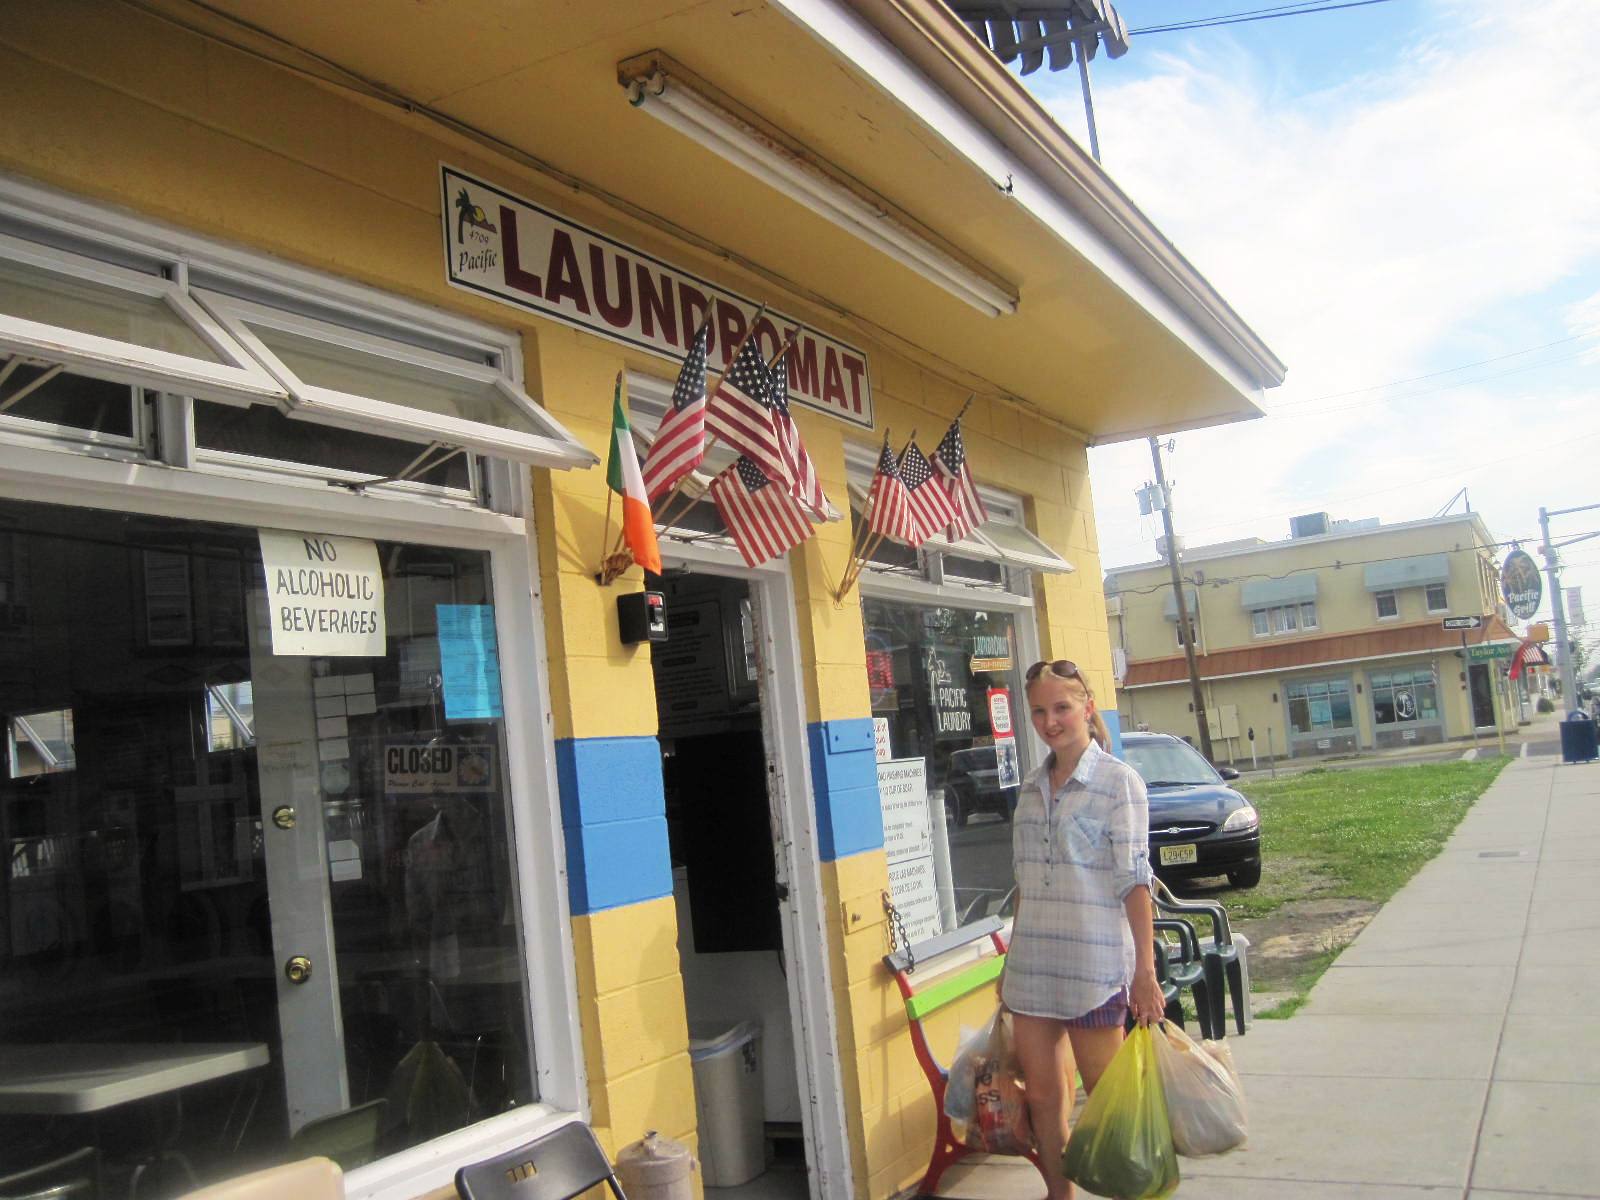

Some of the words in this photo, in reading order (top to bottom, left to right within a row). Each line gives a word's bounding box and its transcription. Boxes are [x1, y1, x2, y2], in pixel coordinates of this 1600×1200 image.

[469, 230, 489, 243] 4709
[459, 249, 497, 272] Pacific
[499, 204, 865, 415] LAUNDROMAT
[303, 539, 337, 562] NO
[276, 568, 374, 601] ALCOHOLIC
[280, 606, 377, 634] BEVERAGES
[940, 687, 967, 708] PACIFIC
[937, 711, 971, 732] LAUNDRY
[387, 747, 451, 774] CLOSED
